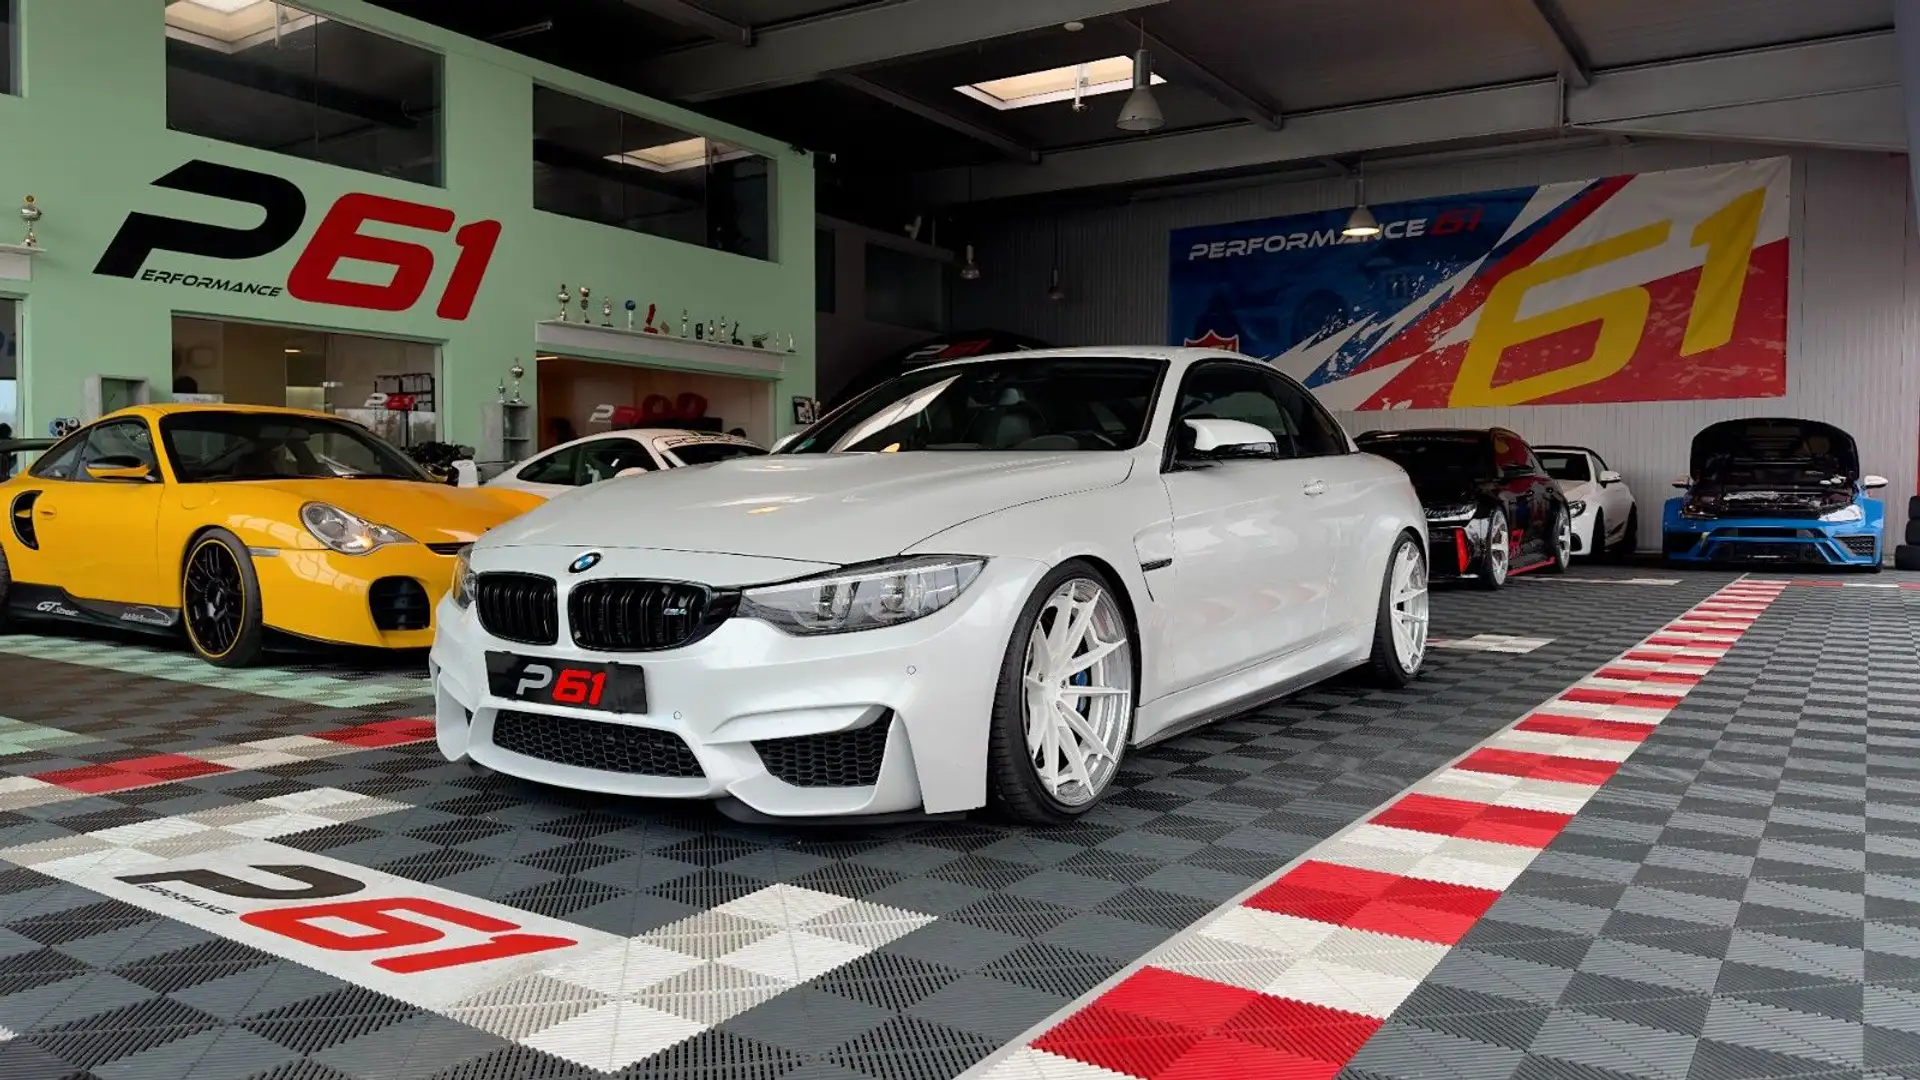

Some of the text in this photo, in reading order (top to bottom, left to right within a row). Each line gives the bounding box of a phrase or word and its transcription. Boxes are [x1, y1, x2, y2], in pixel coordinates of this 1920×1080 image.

[1429, 206, 1485, 238] 61
[1449, 187, 1766, 408] 61
[516, 663, 607, 706] P61
